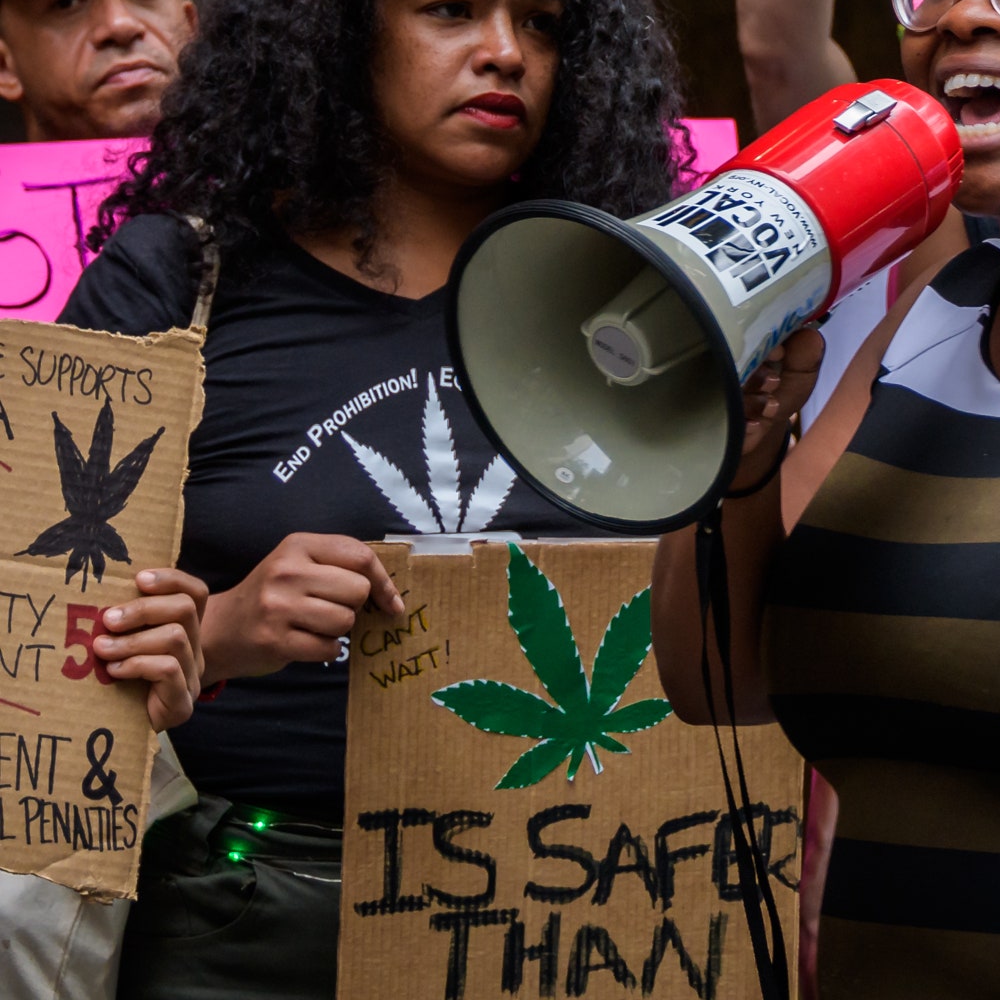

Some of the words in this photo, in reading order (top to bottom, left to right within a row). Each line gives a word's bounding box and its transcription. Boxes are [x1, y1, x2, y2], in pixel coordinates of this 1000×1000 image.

[715, 184, 765, 208] YORK
[695, 190, 791, 275] VOCAL
[769, 213, 803, 256] NEW
[19, 345, 154, 405] SUPPORTS
[369, 639, 450, 690] WAIT!
[81, 727, 124, 806] &
[19, 795, 138, 853] PENALTIES
[354, 806, 496, 917] IS
[523, 802, 803, 913] SAFER
[429, 906, 728, 1000] THAN
